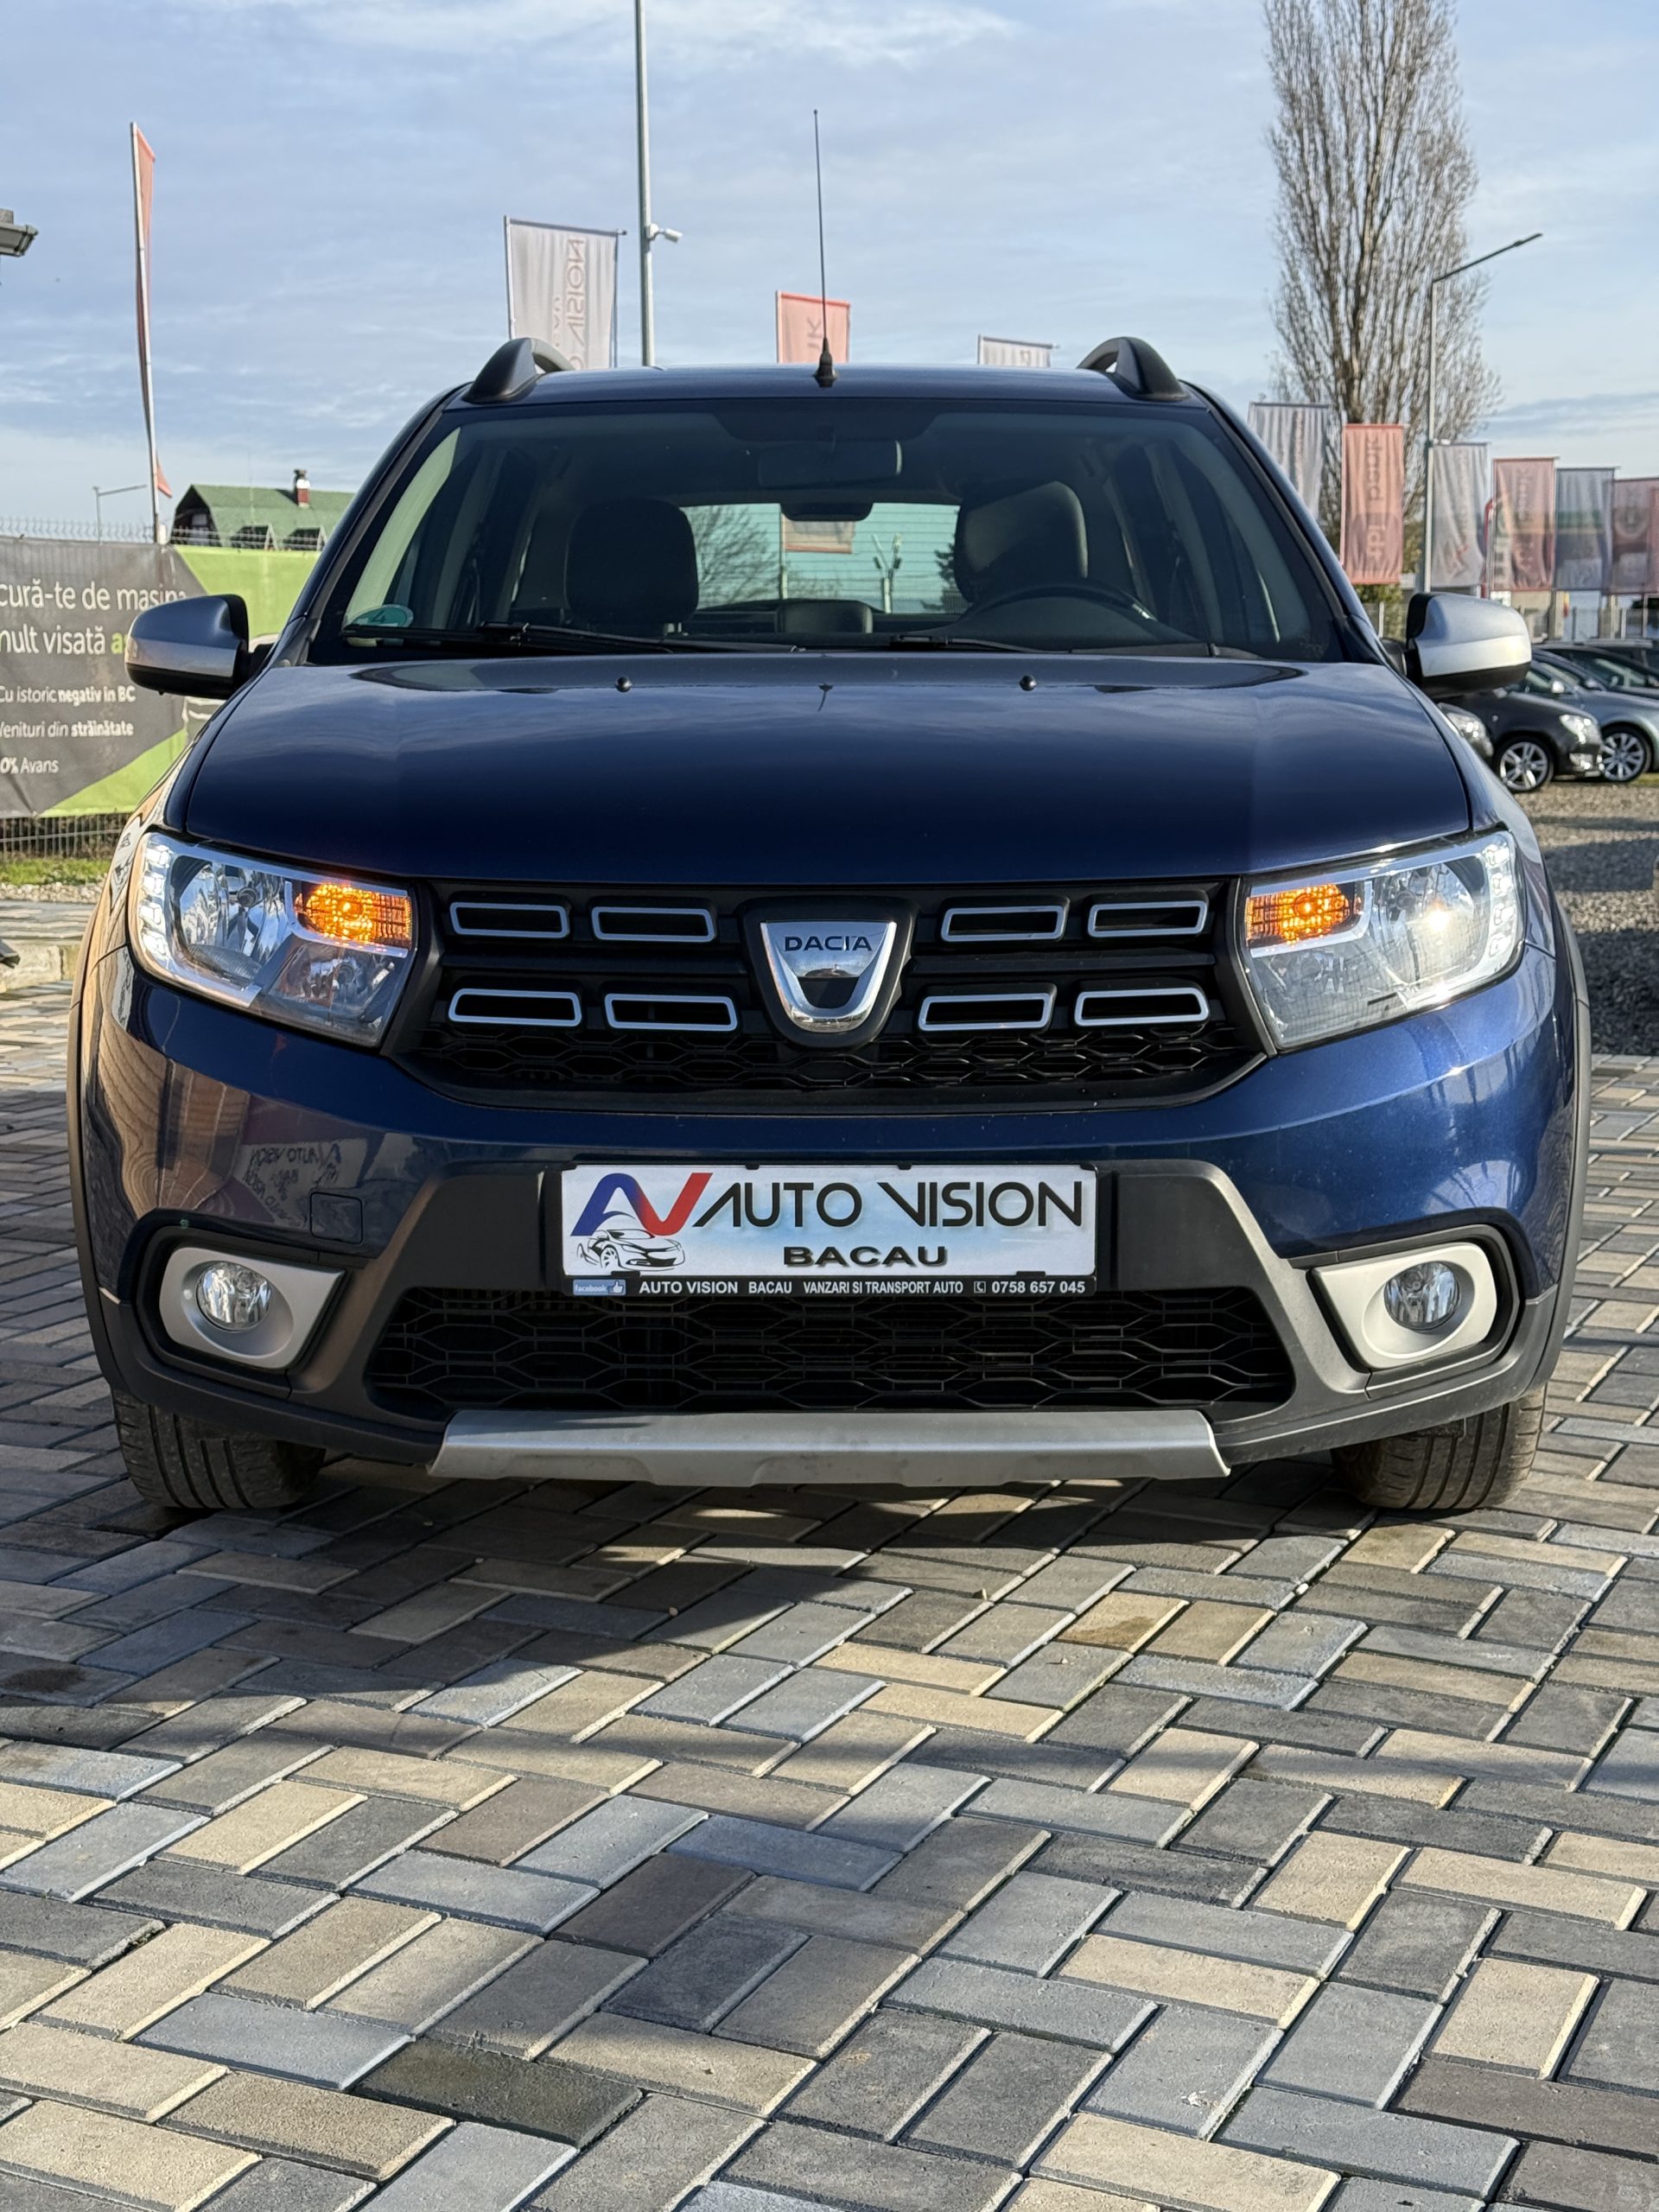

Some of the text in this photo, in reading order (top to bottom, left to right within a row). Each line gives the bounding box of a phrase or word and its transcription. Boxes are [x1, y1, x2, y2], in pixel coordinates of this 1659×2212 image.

[81, 581, 111, 610] de
[43, 625, 106, 655] visată
[16, 686, 58, 703] istoric
[58, 686, 102, 707] negativ
[118, 685, 137, 702] BC
[48, 721, 69, 738] din
[20, 757, 60, 774] Avans
[785, 936, 873, 951] DACIA
[691, 1181, 1082, 1227] AUTO VISION
[783, 1246, 948, 1267] BACAU
[575, 1283, 607, 1293] facebook
[639, 1281, 1085, 1294] AUTO VISION BACAU VANZARI SI TRANSPORT AUTO 0758 657 045
